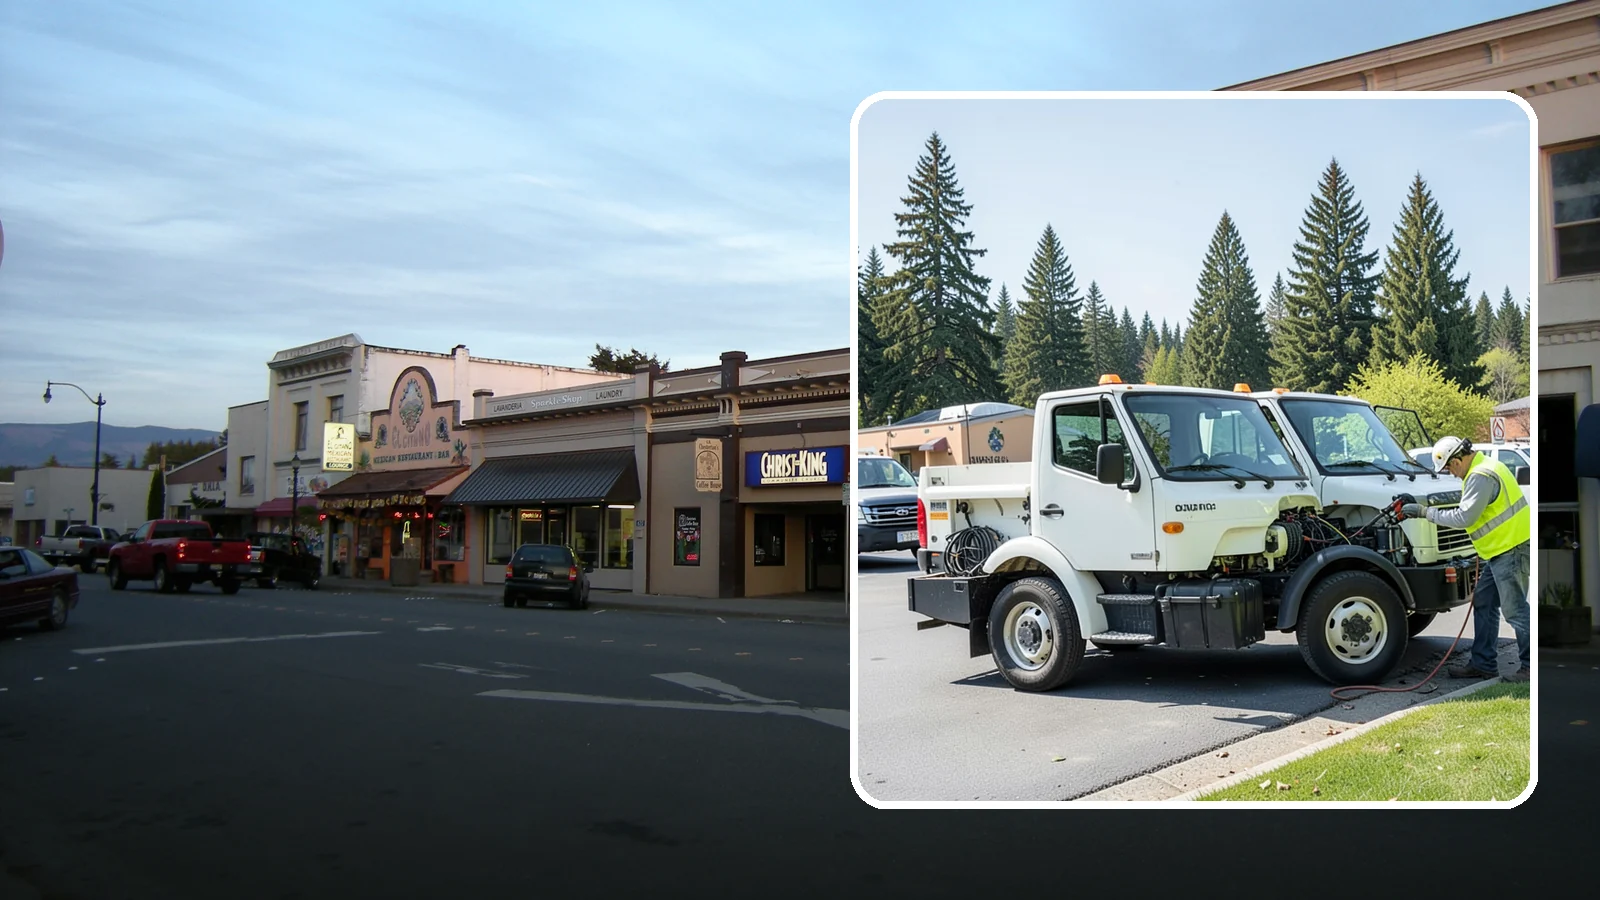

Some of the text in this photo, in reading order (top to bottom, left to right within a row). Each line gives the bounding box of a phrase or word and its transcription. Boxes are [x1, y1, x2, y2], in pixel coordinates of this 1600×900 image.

[595, 389, 624, 400] LAUNDRY
[493, 402, 523, 412] LAVANDERIA
[531, 394, 583, 409] Sparkle Shop
[373, 455, 396, 464] MEXICAN
[397, 451, 433, 462] RESTAURANT
[438, 450, 450, 459] BAR
[761, 450, 827, 478] CHRIST KING
[696, 480, 709, 488] Coffee
